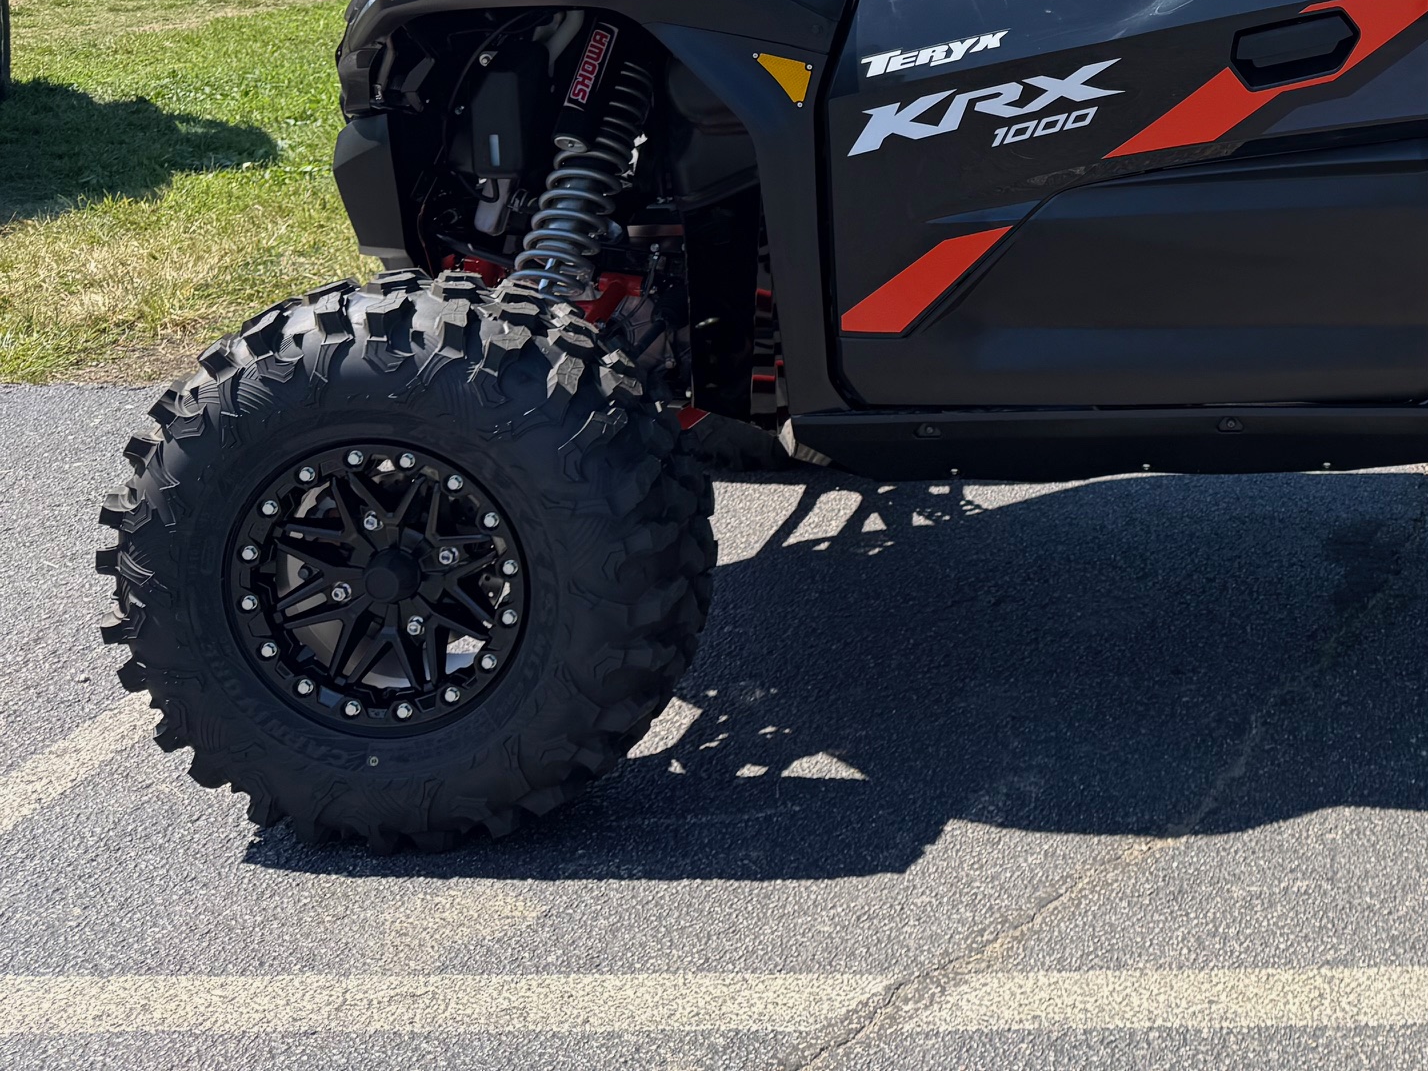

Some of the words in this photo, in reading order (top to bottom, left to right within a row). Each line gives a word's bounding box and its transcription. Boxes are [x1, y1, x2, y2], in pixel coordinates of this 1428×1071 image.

[570, 29, 611, 104] SHOWA
[861, 28, 1011, 78] TERYX
[847, 57, 1126, 157] KRX
[991, 106, 1099, 148] 1000
